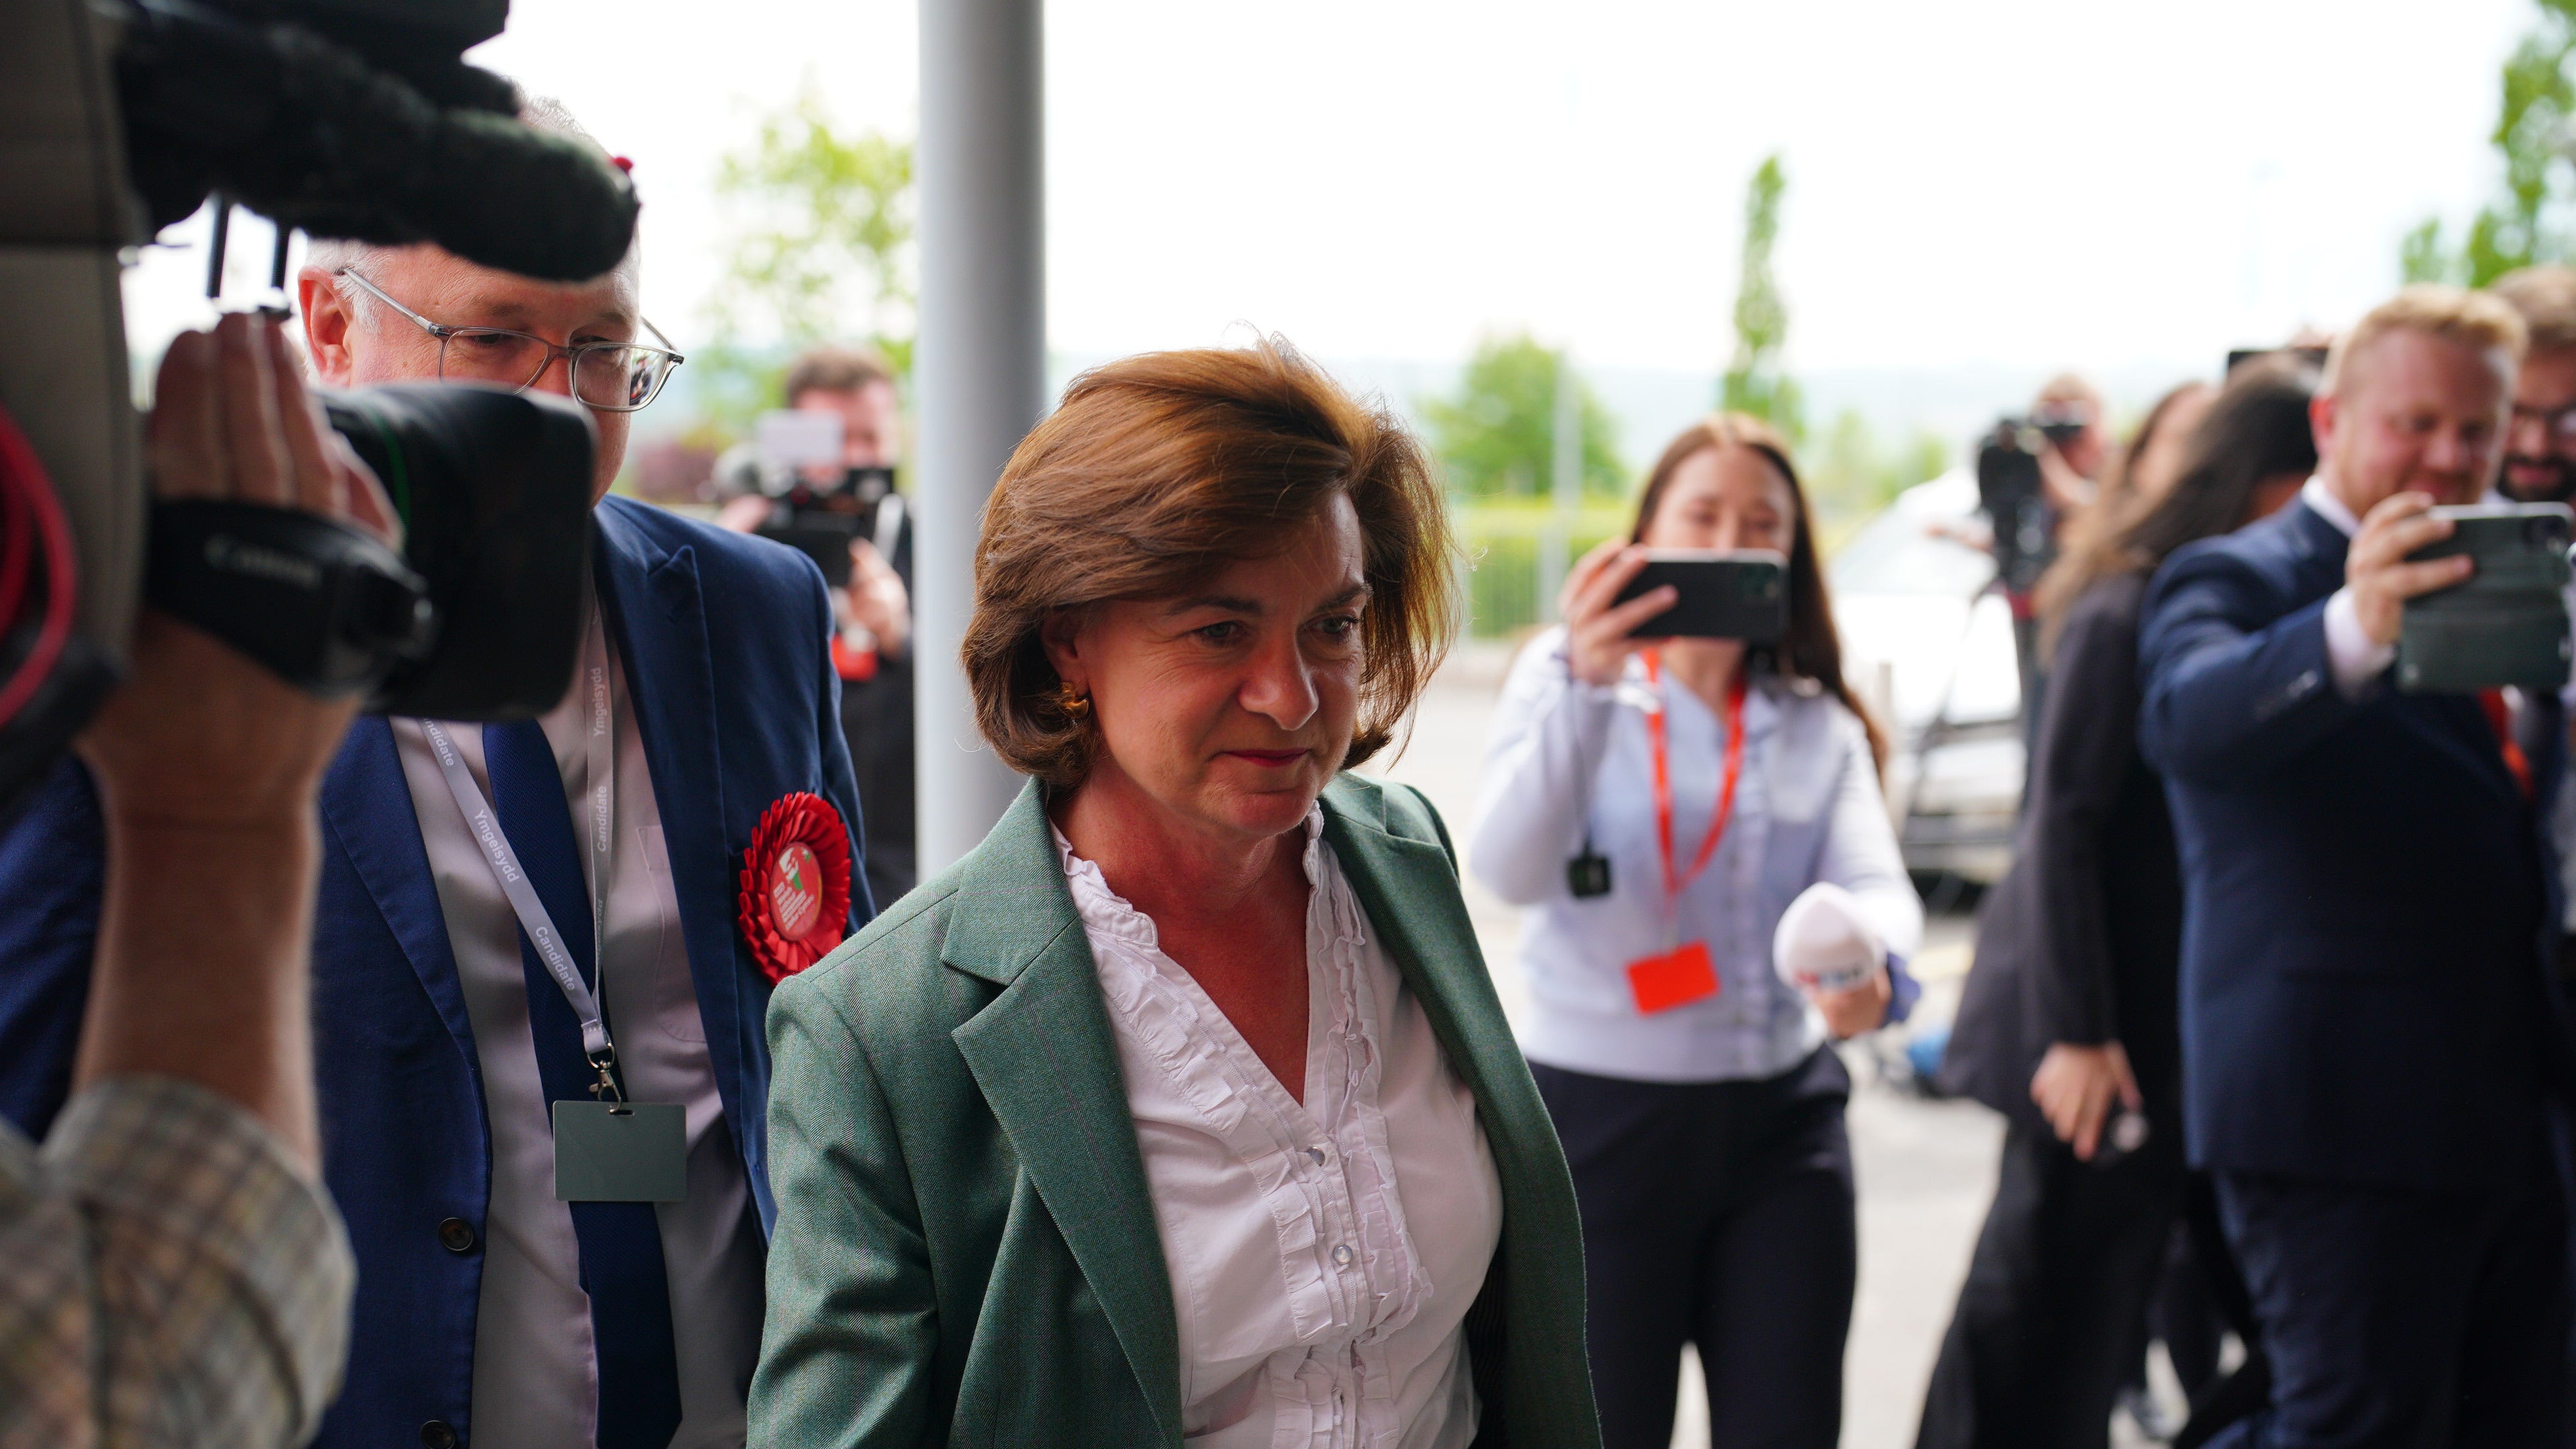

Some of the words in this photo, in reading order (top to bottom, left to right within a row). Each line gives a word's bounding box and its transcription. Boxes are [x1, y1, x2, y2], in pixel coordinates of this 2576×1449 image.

[591, 667, 607, 737] Ymgeisydd
[596, 785, 607, 852] Candidate
[424, 719, 454, 766] ndidate
[474, 809, 519, 882] Ymgeisydd
[535, 927, 575, 990] Candidate
